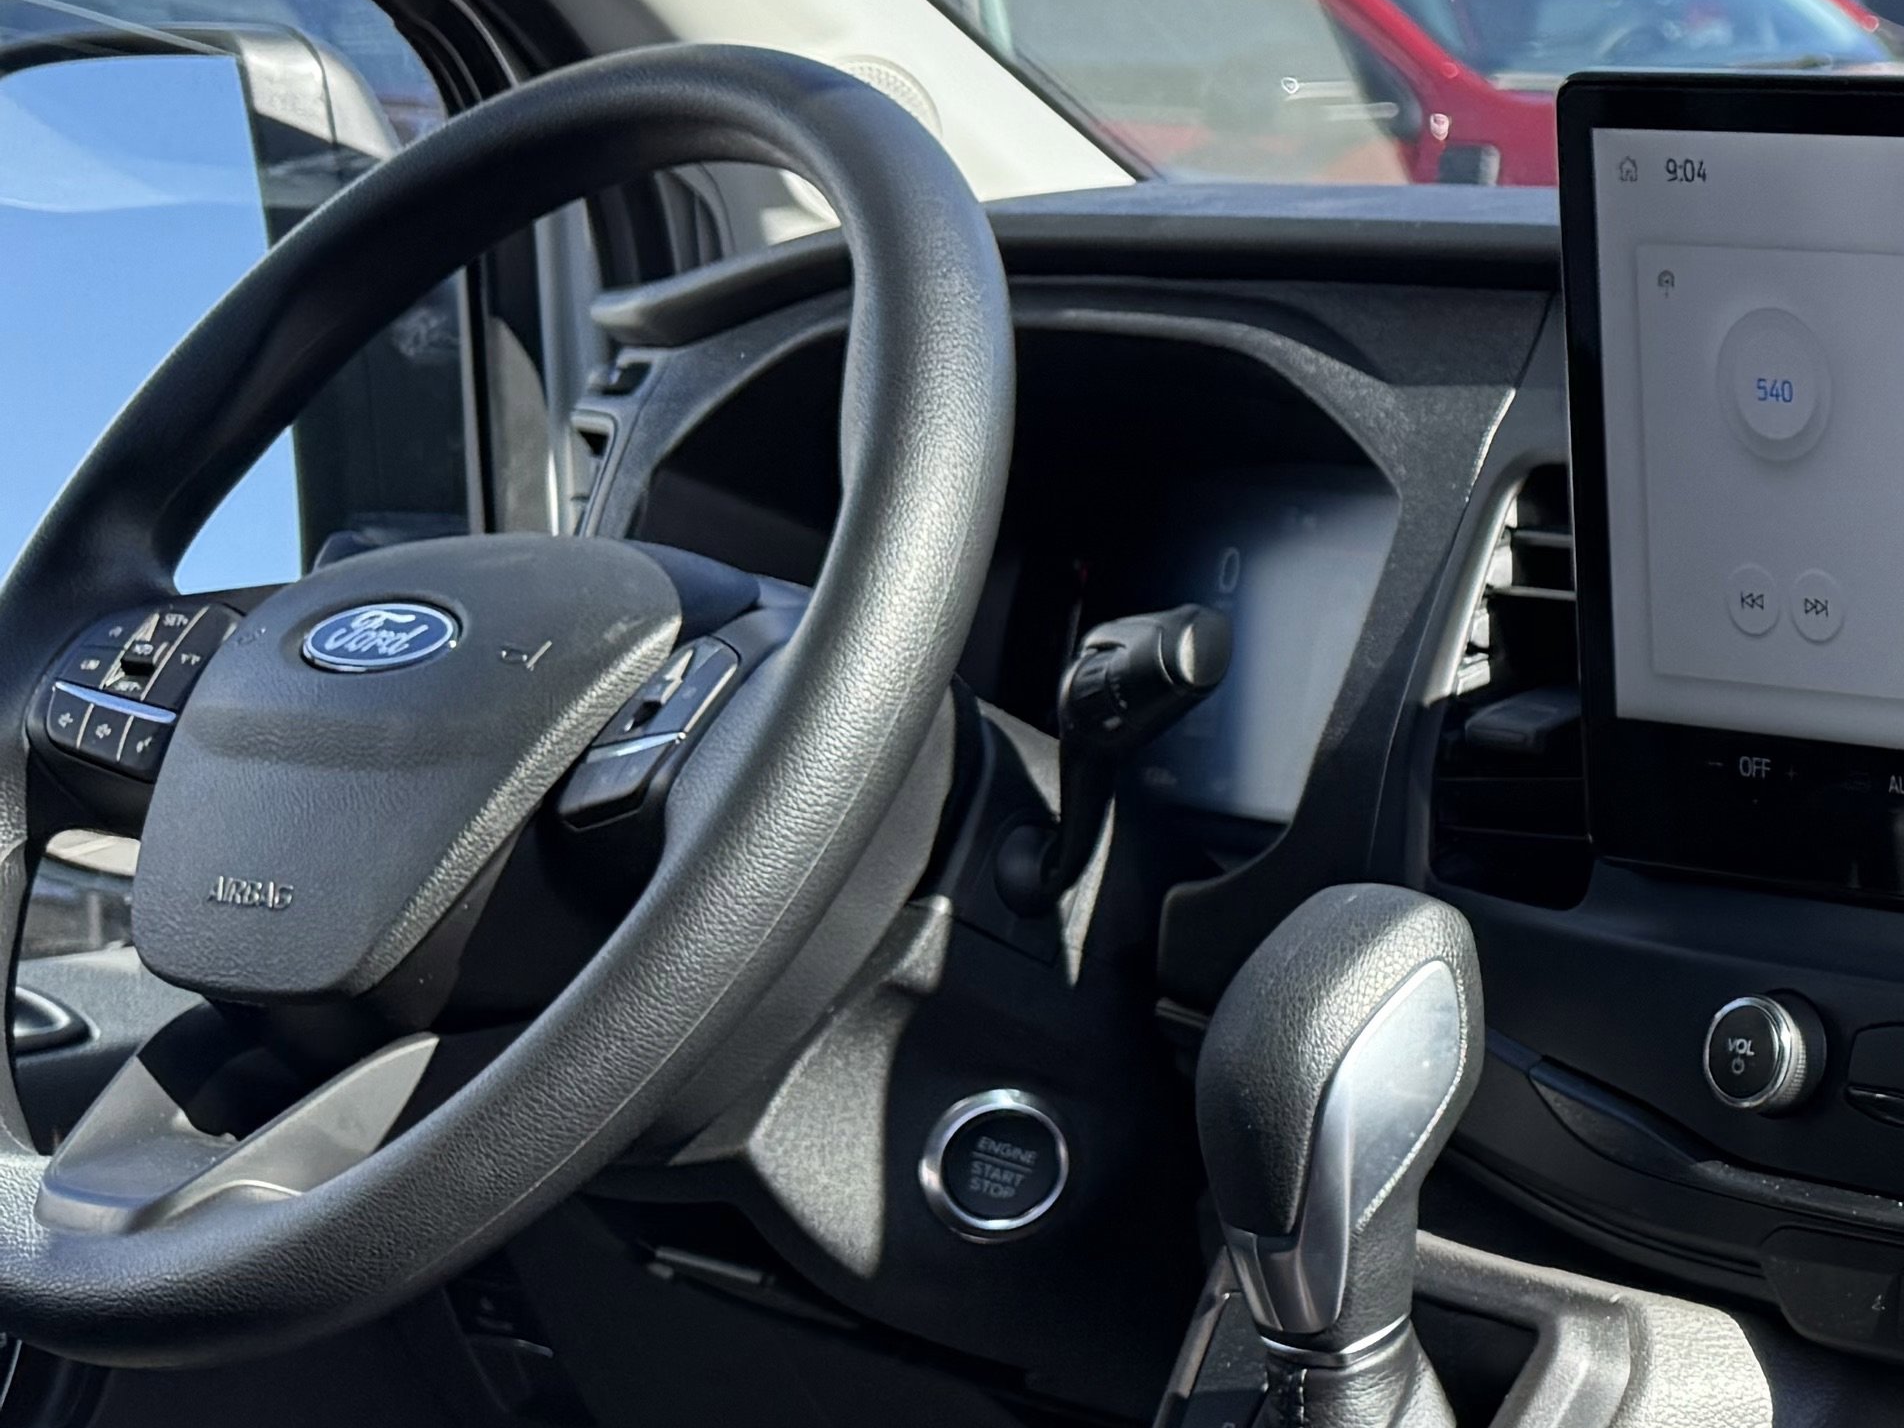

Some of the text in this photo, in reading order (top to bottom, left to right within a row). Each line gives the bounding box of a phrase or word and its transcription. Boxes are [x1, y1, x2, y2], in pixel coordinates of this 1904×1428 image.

[1664, 158, 1708, 184] 9:04
[1755, 378, 1794, 404] 540
[326, 609, 430, 655] Ford
[1739, 756, 1771, 779] OFF
[208, 876, 293, 910] AIRBAG
[1728, 1038, 1755, 1057] VOL
[977, 1136, 1037, 1164] ENGINE
[970, 1161, 1025, 1187] START
[969, 1177, 1015, 1198] STOP
